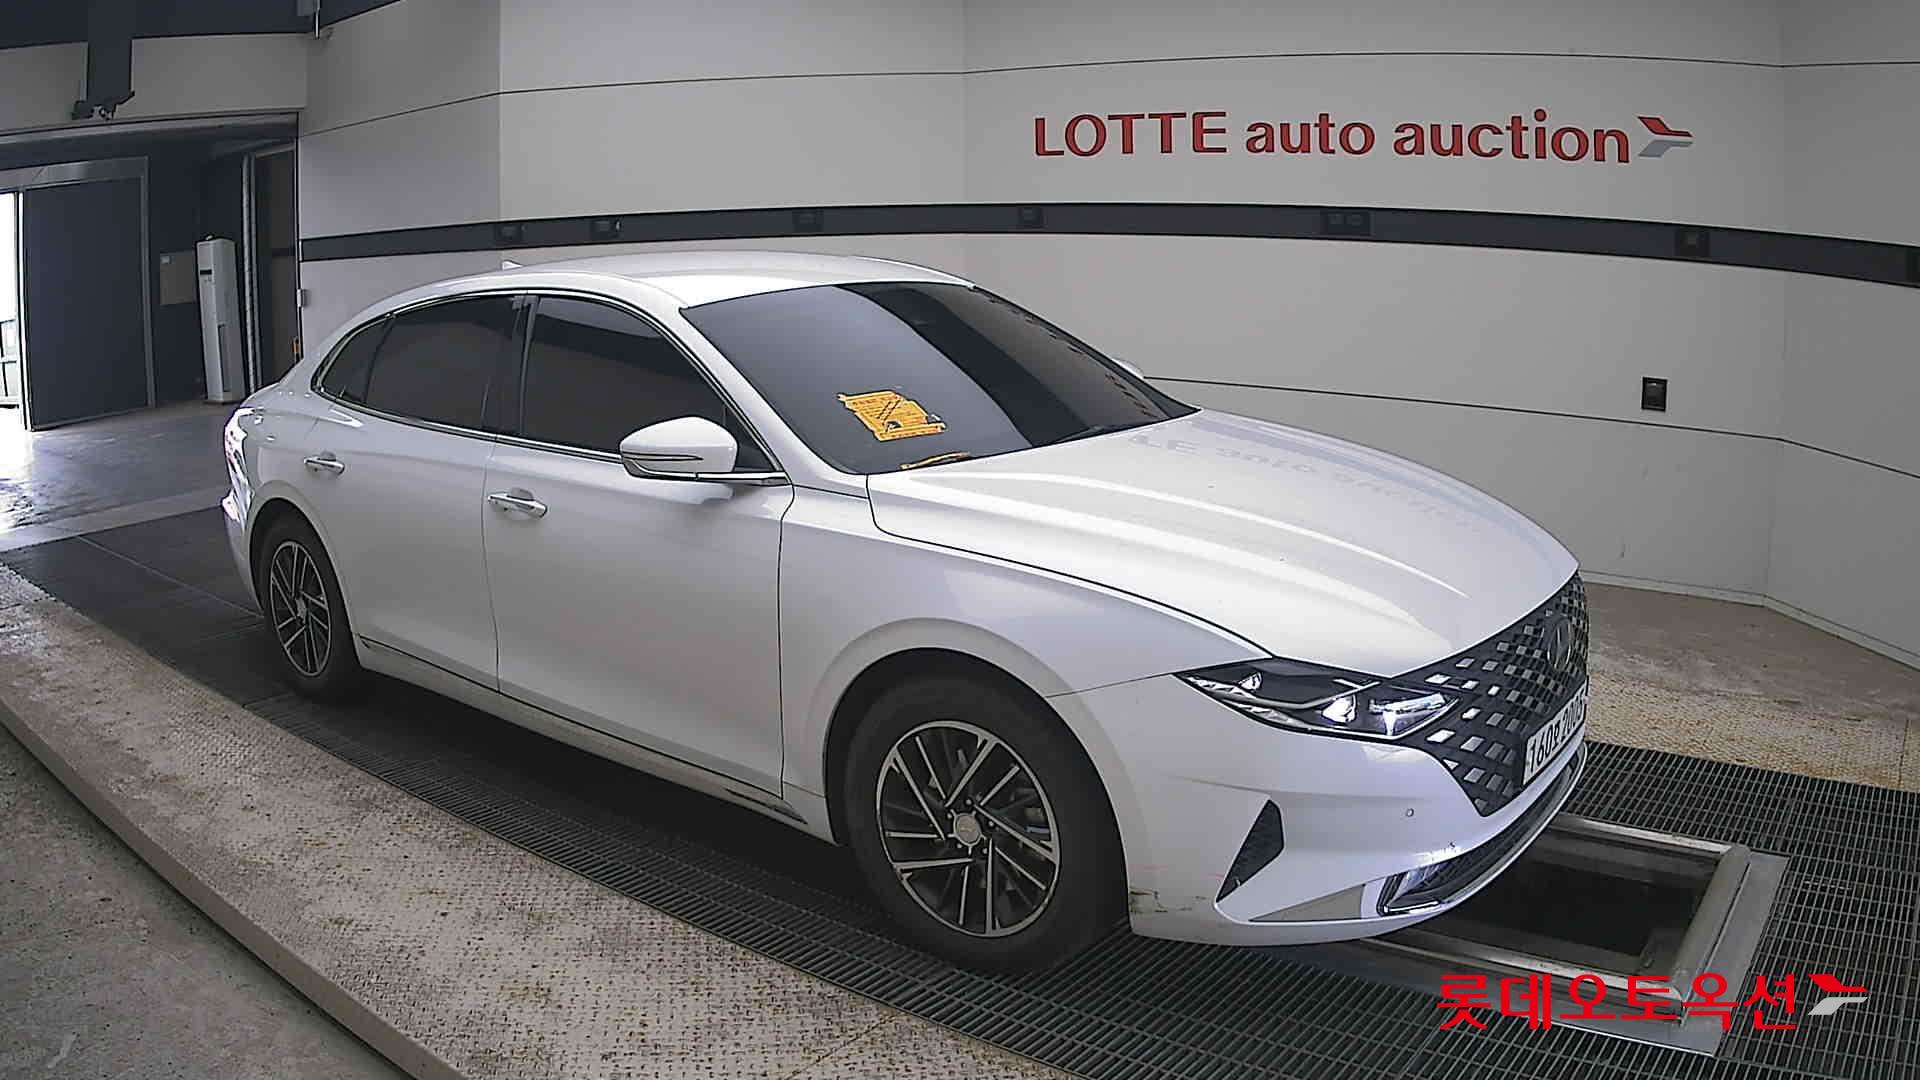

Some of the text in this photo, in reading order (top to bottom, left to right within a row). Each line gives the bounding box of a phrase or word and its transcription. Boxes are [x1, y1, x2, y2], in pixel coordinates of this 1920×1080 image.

[1035, 109, 1629, 163] LOTTE auto auction
